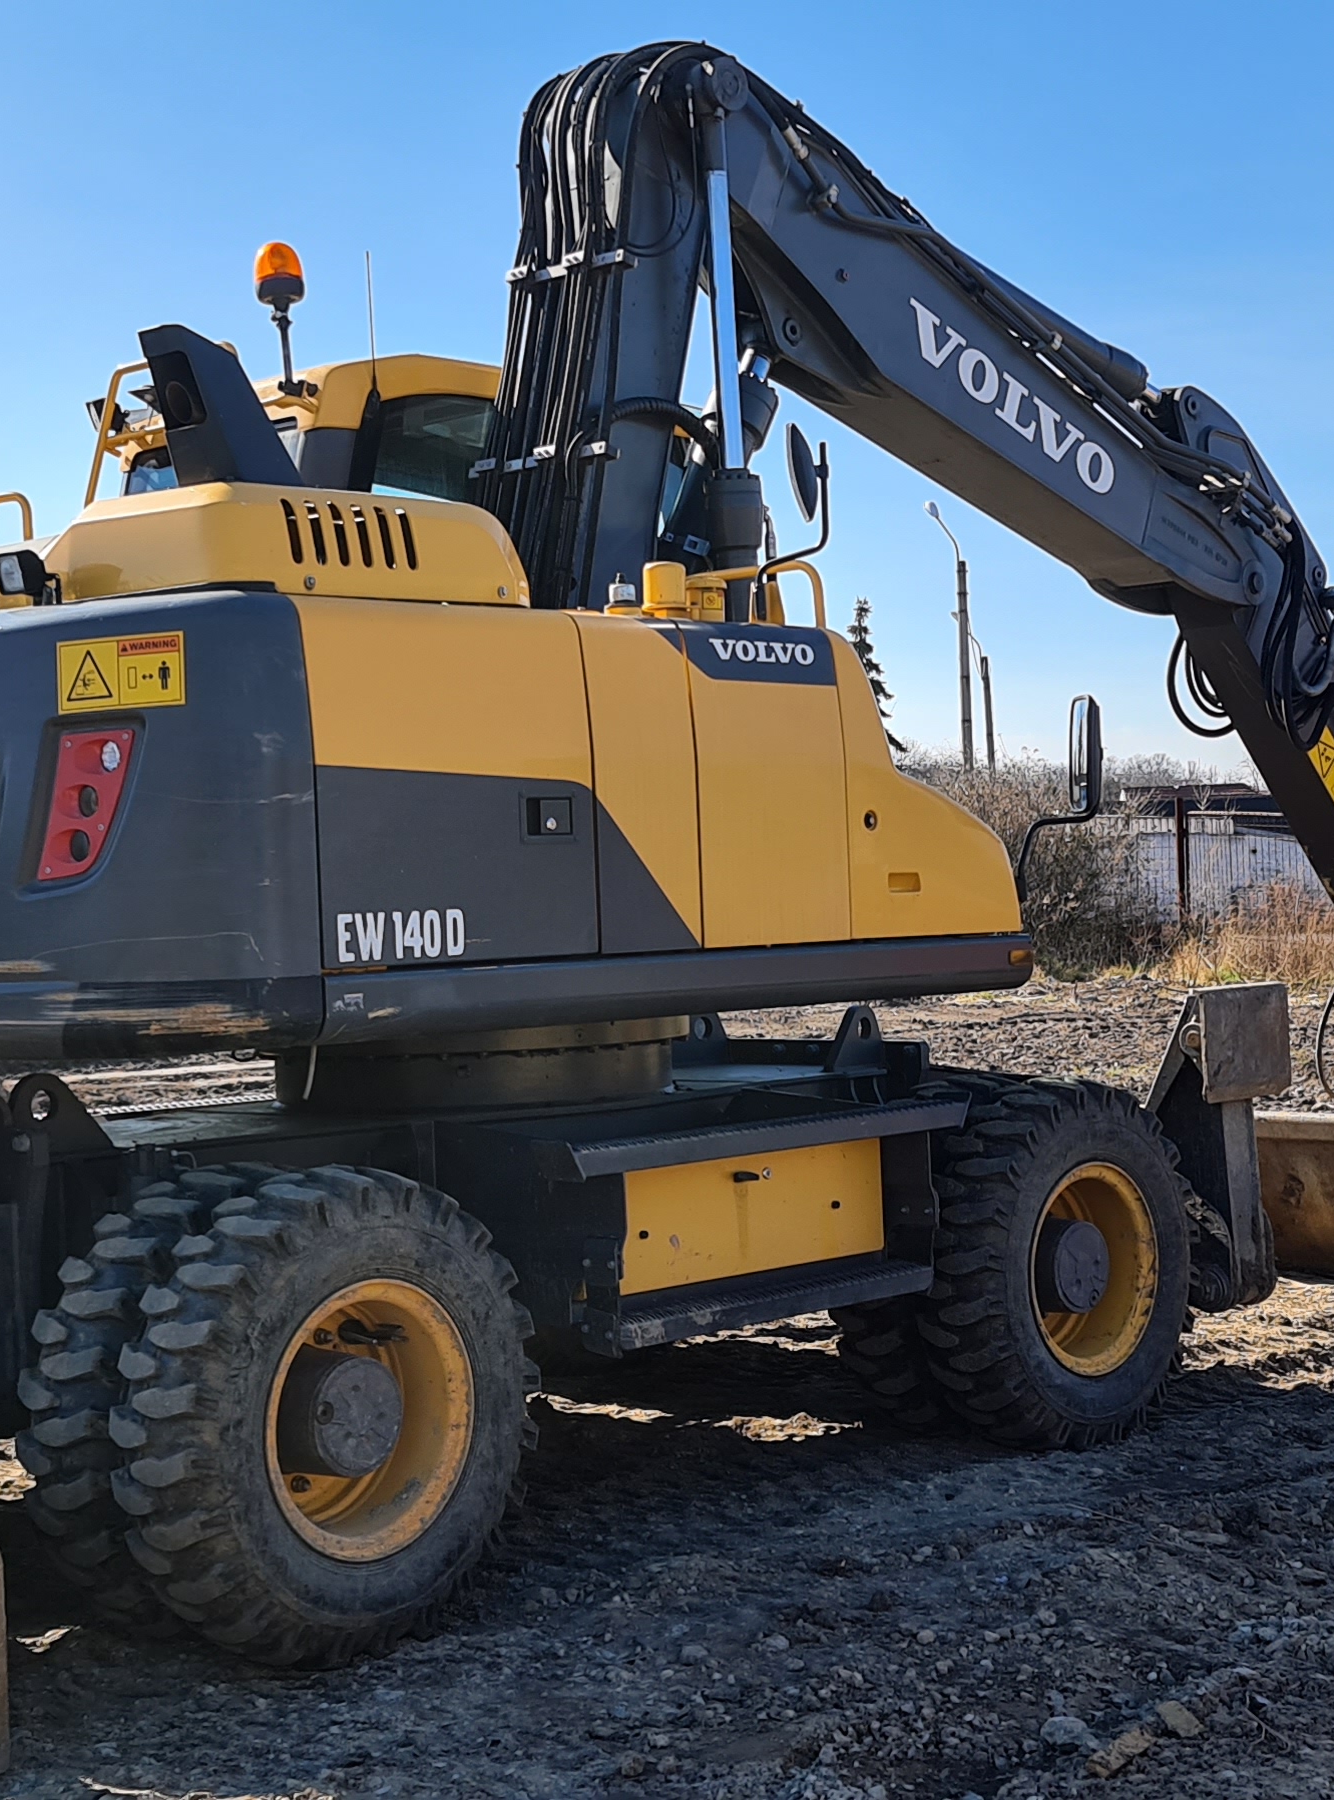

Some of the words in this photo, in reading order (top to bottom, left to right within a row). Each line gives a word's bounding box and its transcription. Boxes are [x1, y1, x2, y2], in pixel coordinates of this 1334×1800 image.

[910, 297, 1115, 494] VOLVO
[129, 639, 177, 651] WARNING
[708, 638, 815, 665] VOLVO
